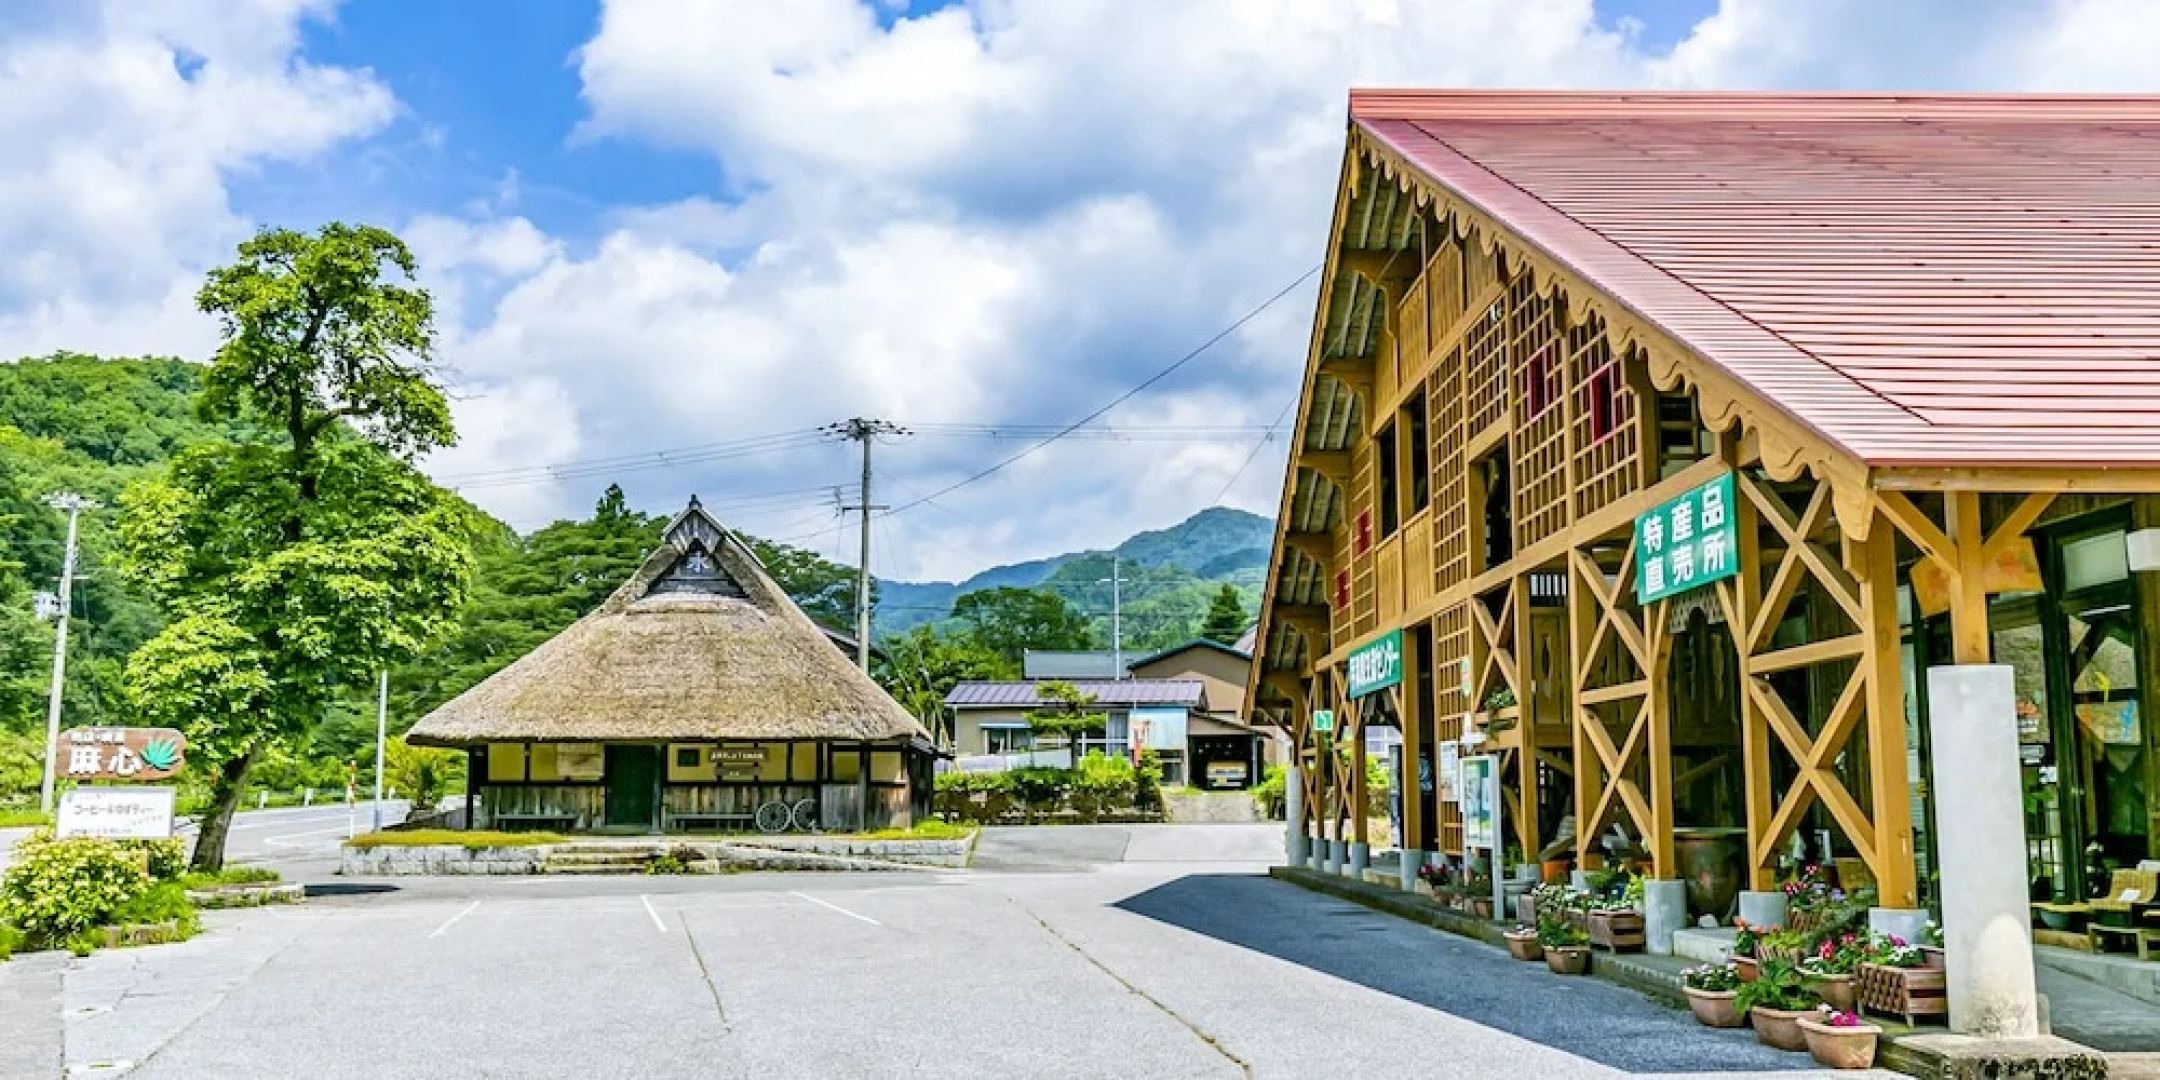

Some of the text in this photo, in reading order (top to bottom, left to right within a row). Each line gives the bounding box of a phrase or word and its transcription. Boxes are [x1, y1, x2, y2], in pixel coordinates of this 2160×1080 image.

[1643, 484, 1725, 555] 特産品
[1643, 529, 1726, 595] 直売所
